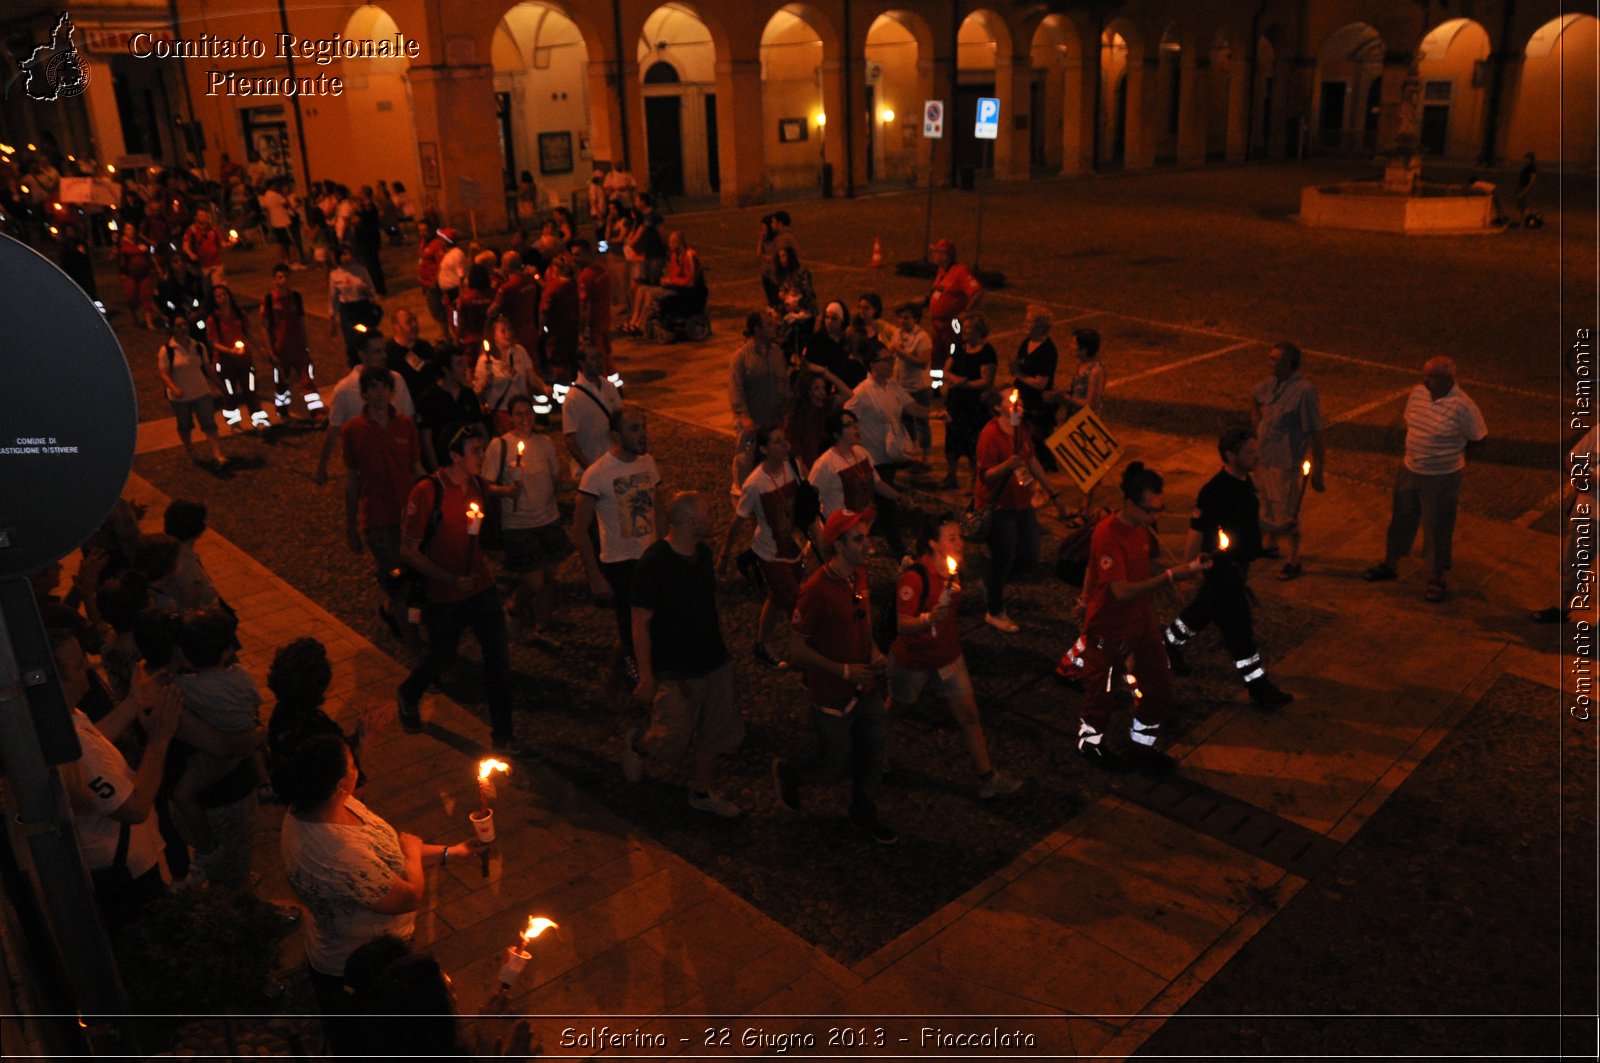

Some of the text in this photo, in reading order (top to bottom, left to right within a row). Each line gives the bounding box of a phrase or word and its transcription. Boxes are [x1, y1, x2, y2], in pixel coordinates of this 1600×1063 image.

[980, 100, 997, 122] P
[16, 437, 57, 445] COMUNE DI
[1055, 415, 1119, 482] IVREA
[87, 776, 116, 799] 5
